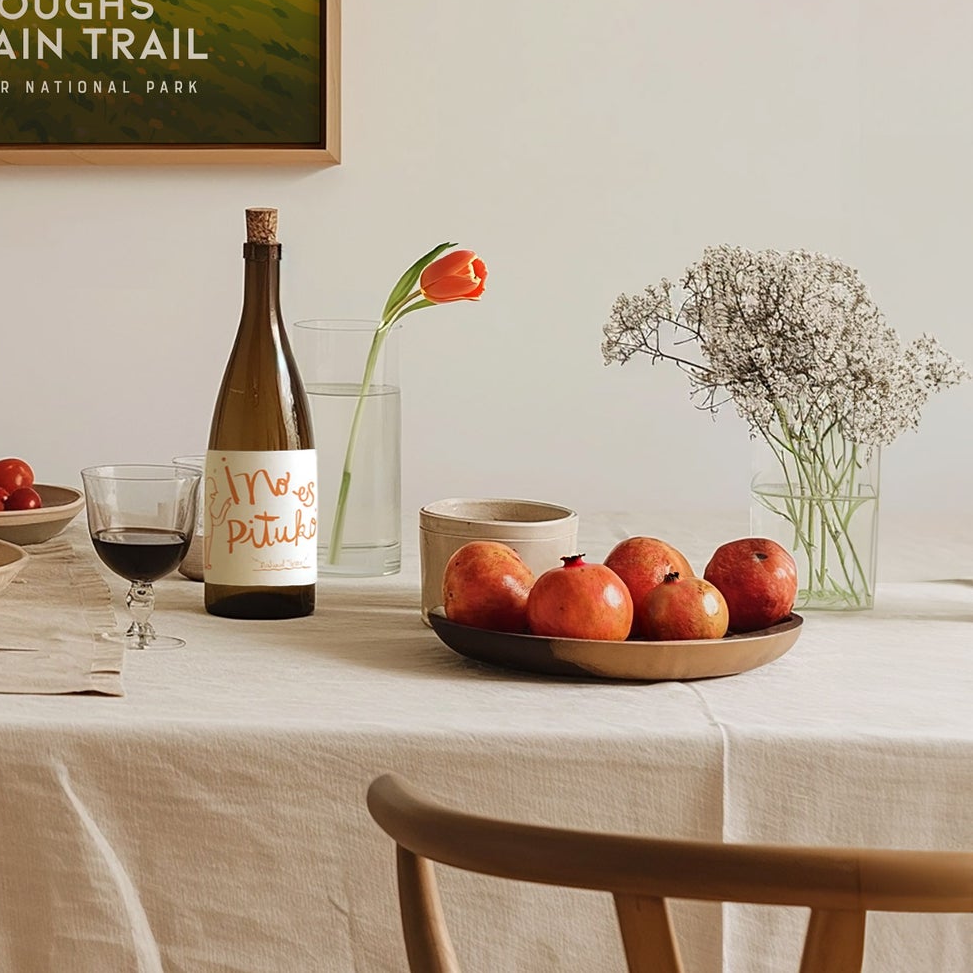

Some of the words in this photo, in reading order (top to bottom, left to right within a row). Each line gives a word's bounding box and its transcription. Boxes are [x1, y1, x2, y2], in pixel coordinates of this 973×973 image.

[82, 27, 208, 60] TRAIL
[25, 80, 130, 94] NATIONAL
[146, 80, 198, 94] PARK
[292, 481, 315, 507] es
